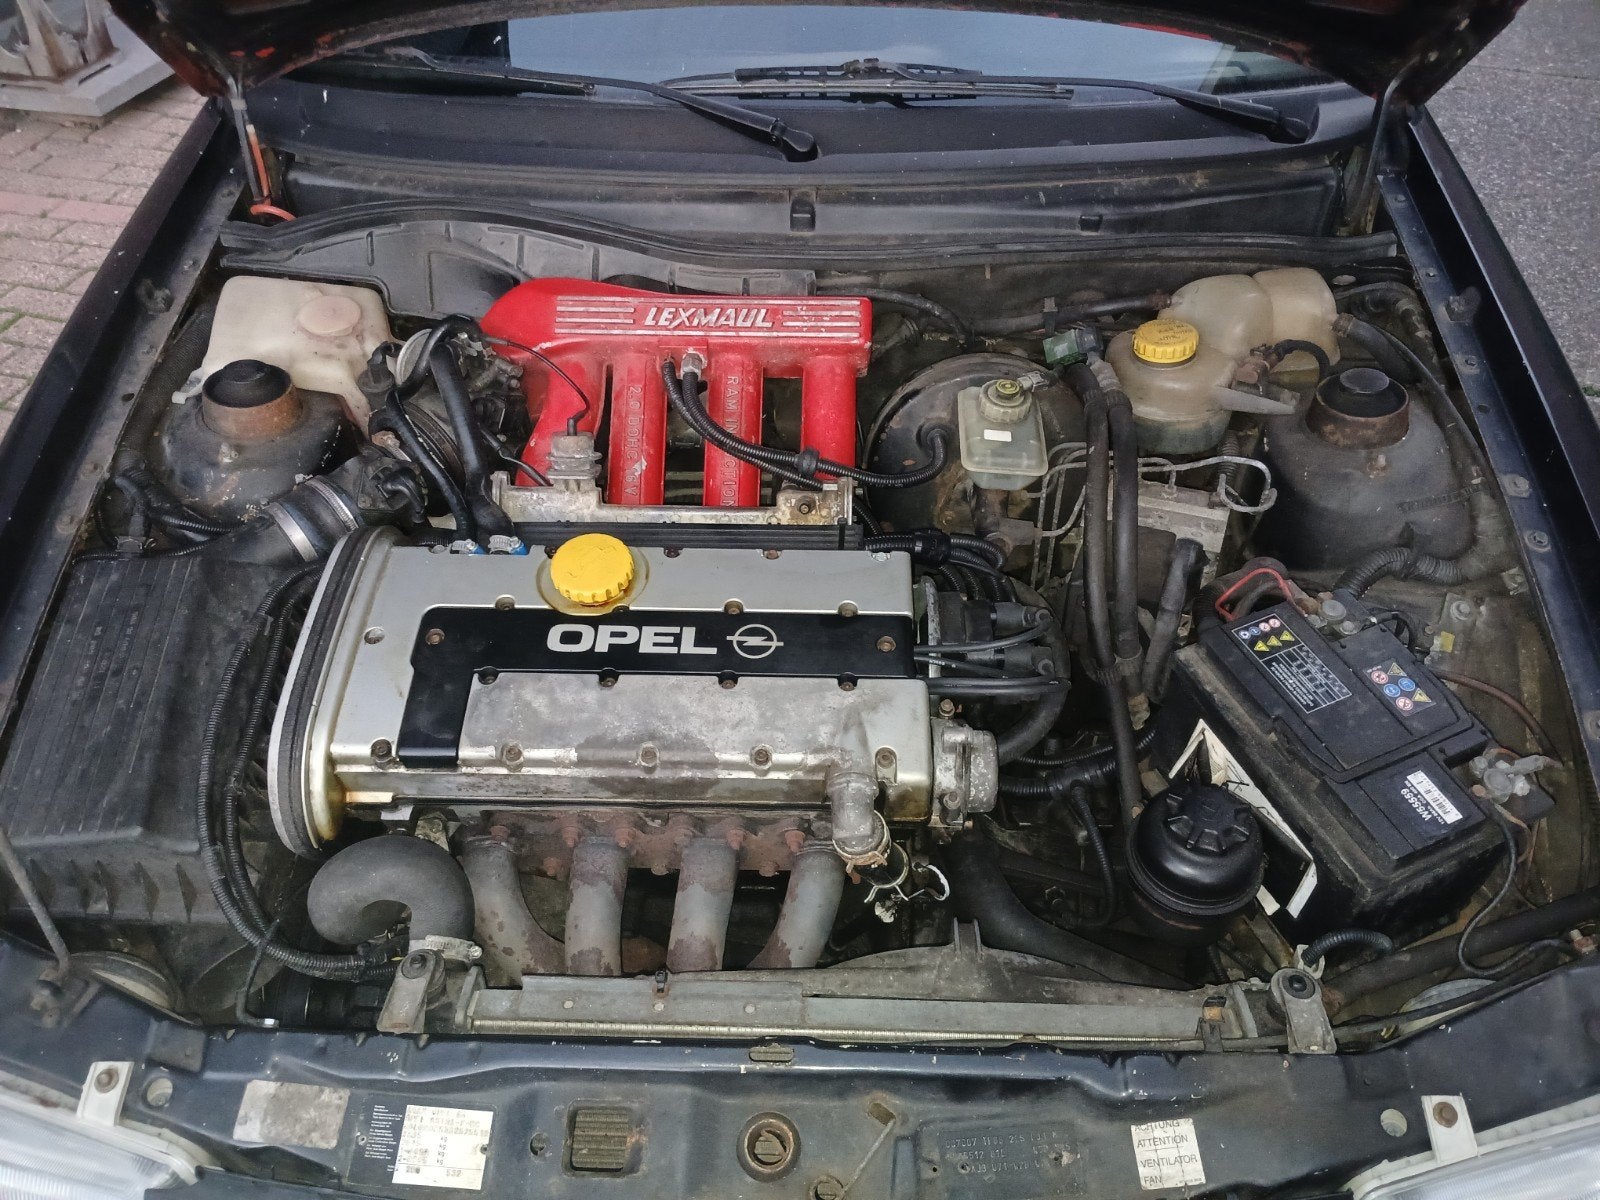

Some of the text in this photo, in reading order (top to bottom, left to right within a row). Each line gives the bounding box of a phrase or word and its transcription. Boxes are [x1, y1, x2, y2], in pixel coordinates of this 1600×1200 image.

[644, 307, 773, 329] LEXMAUL
[628, 385, 642, 410] 2.0
[626, 416, 640, 460] DOHC
[722, 375, 739, 507] RAM INCTION
[546, 623, 718, 655] OPEL
[1400, 788, 1432, 821] W55559
[1137, 1134, 1189, 1148] ATTENTION
[1140, 1154, 1198, 1168] VENTILATOR
[1144, 1175, 1162, 1185] FAN
